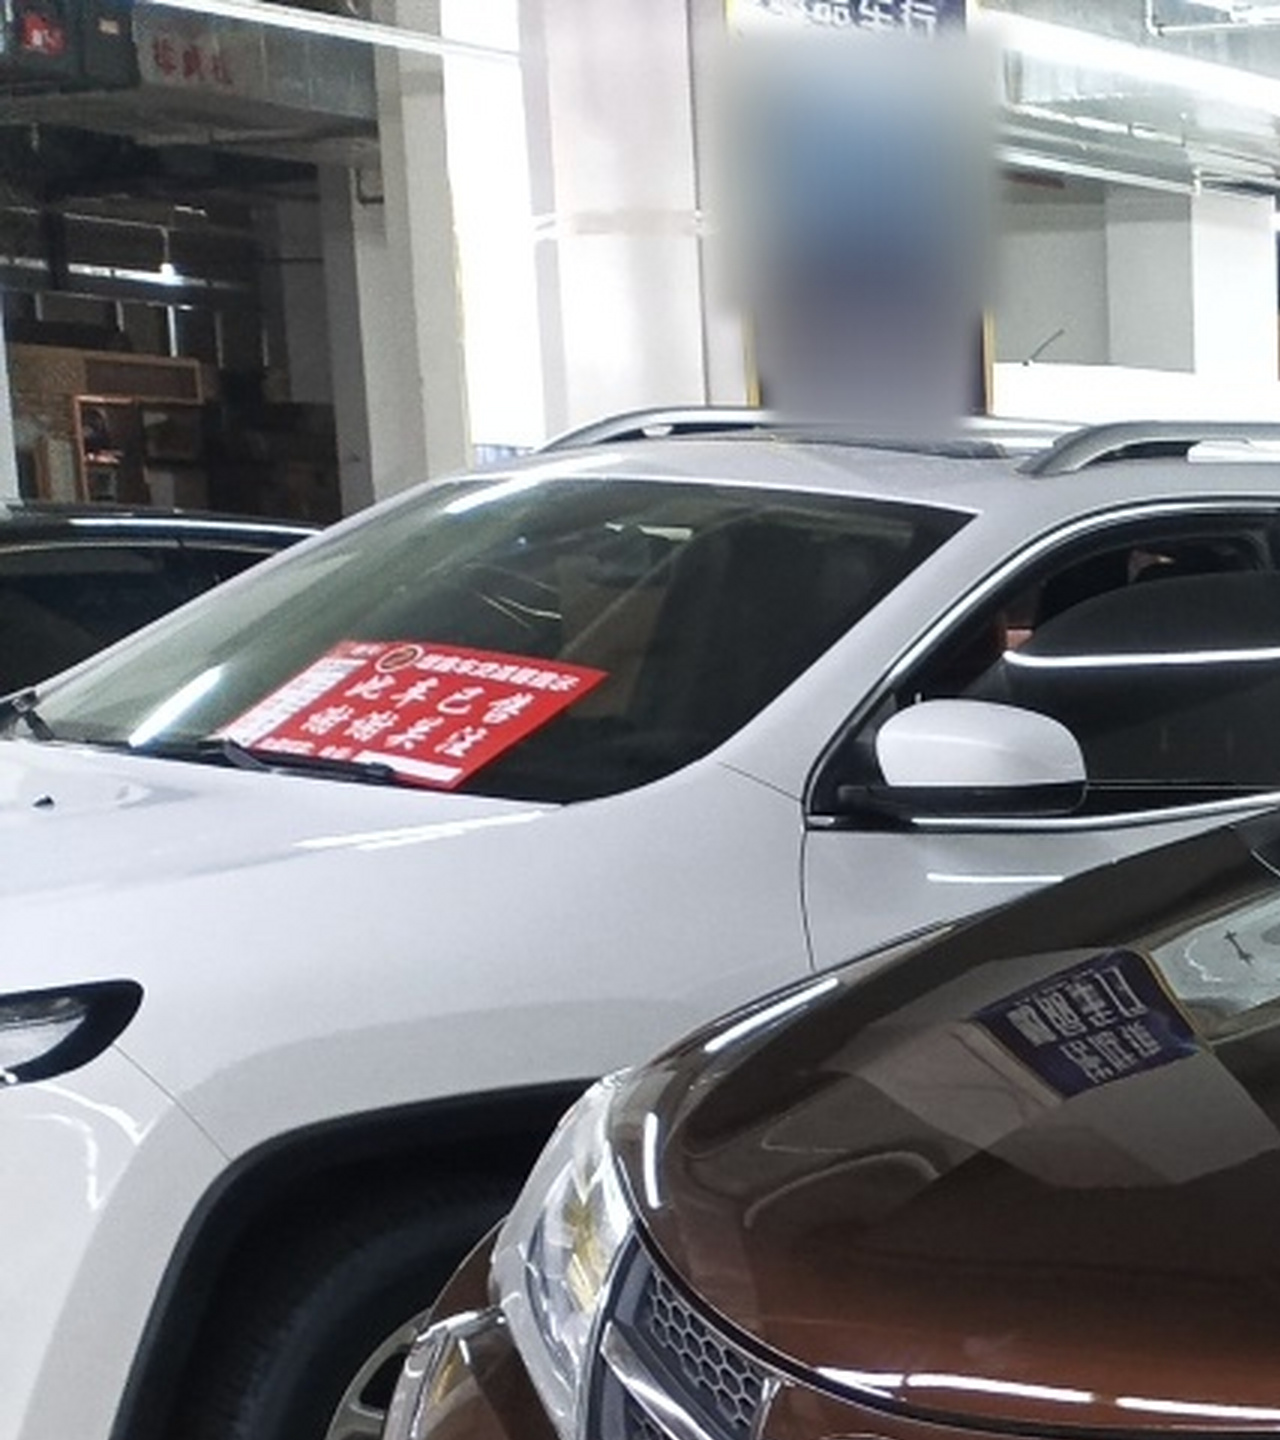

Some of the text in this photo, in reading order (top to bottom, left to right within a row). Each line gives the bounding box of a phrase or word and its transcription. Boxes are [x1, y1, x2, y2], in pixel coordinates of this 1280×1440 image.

[344, 673, 535, 727] 此车已售
[299, 705, 490, 758] 谢谢关注
